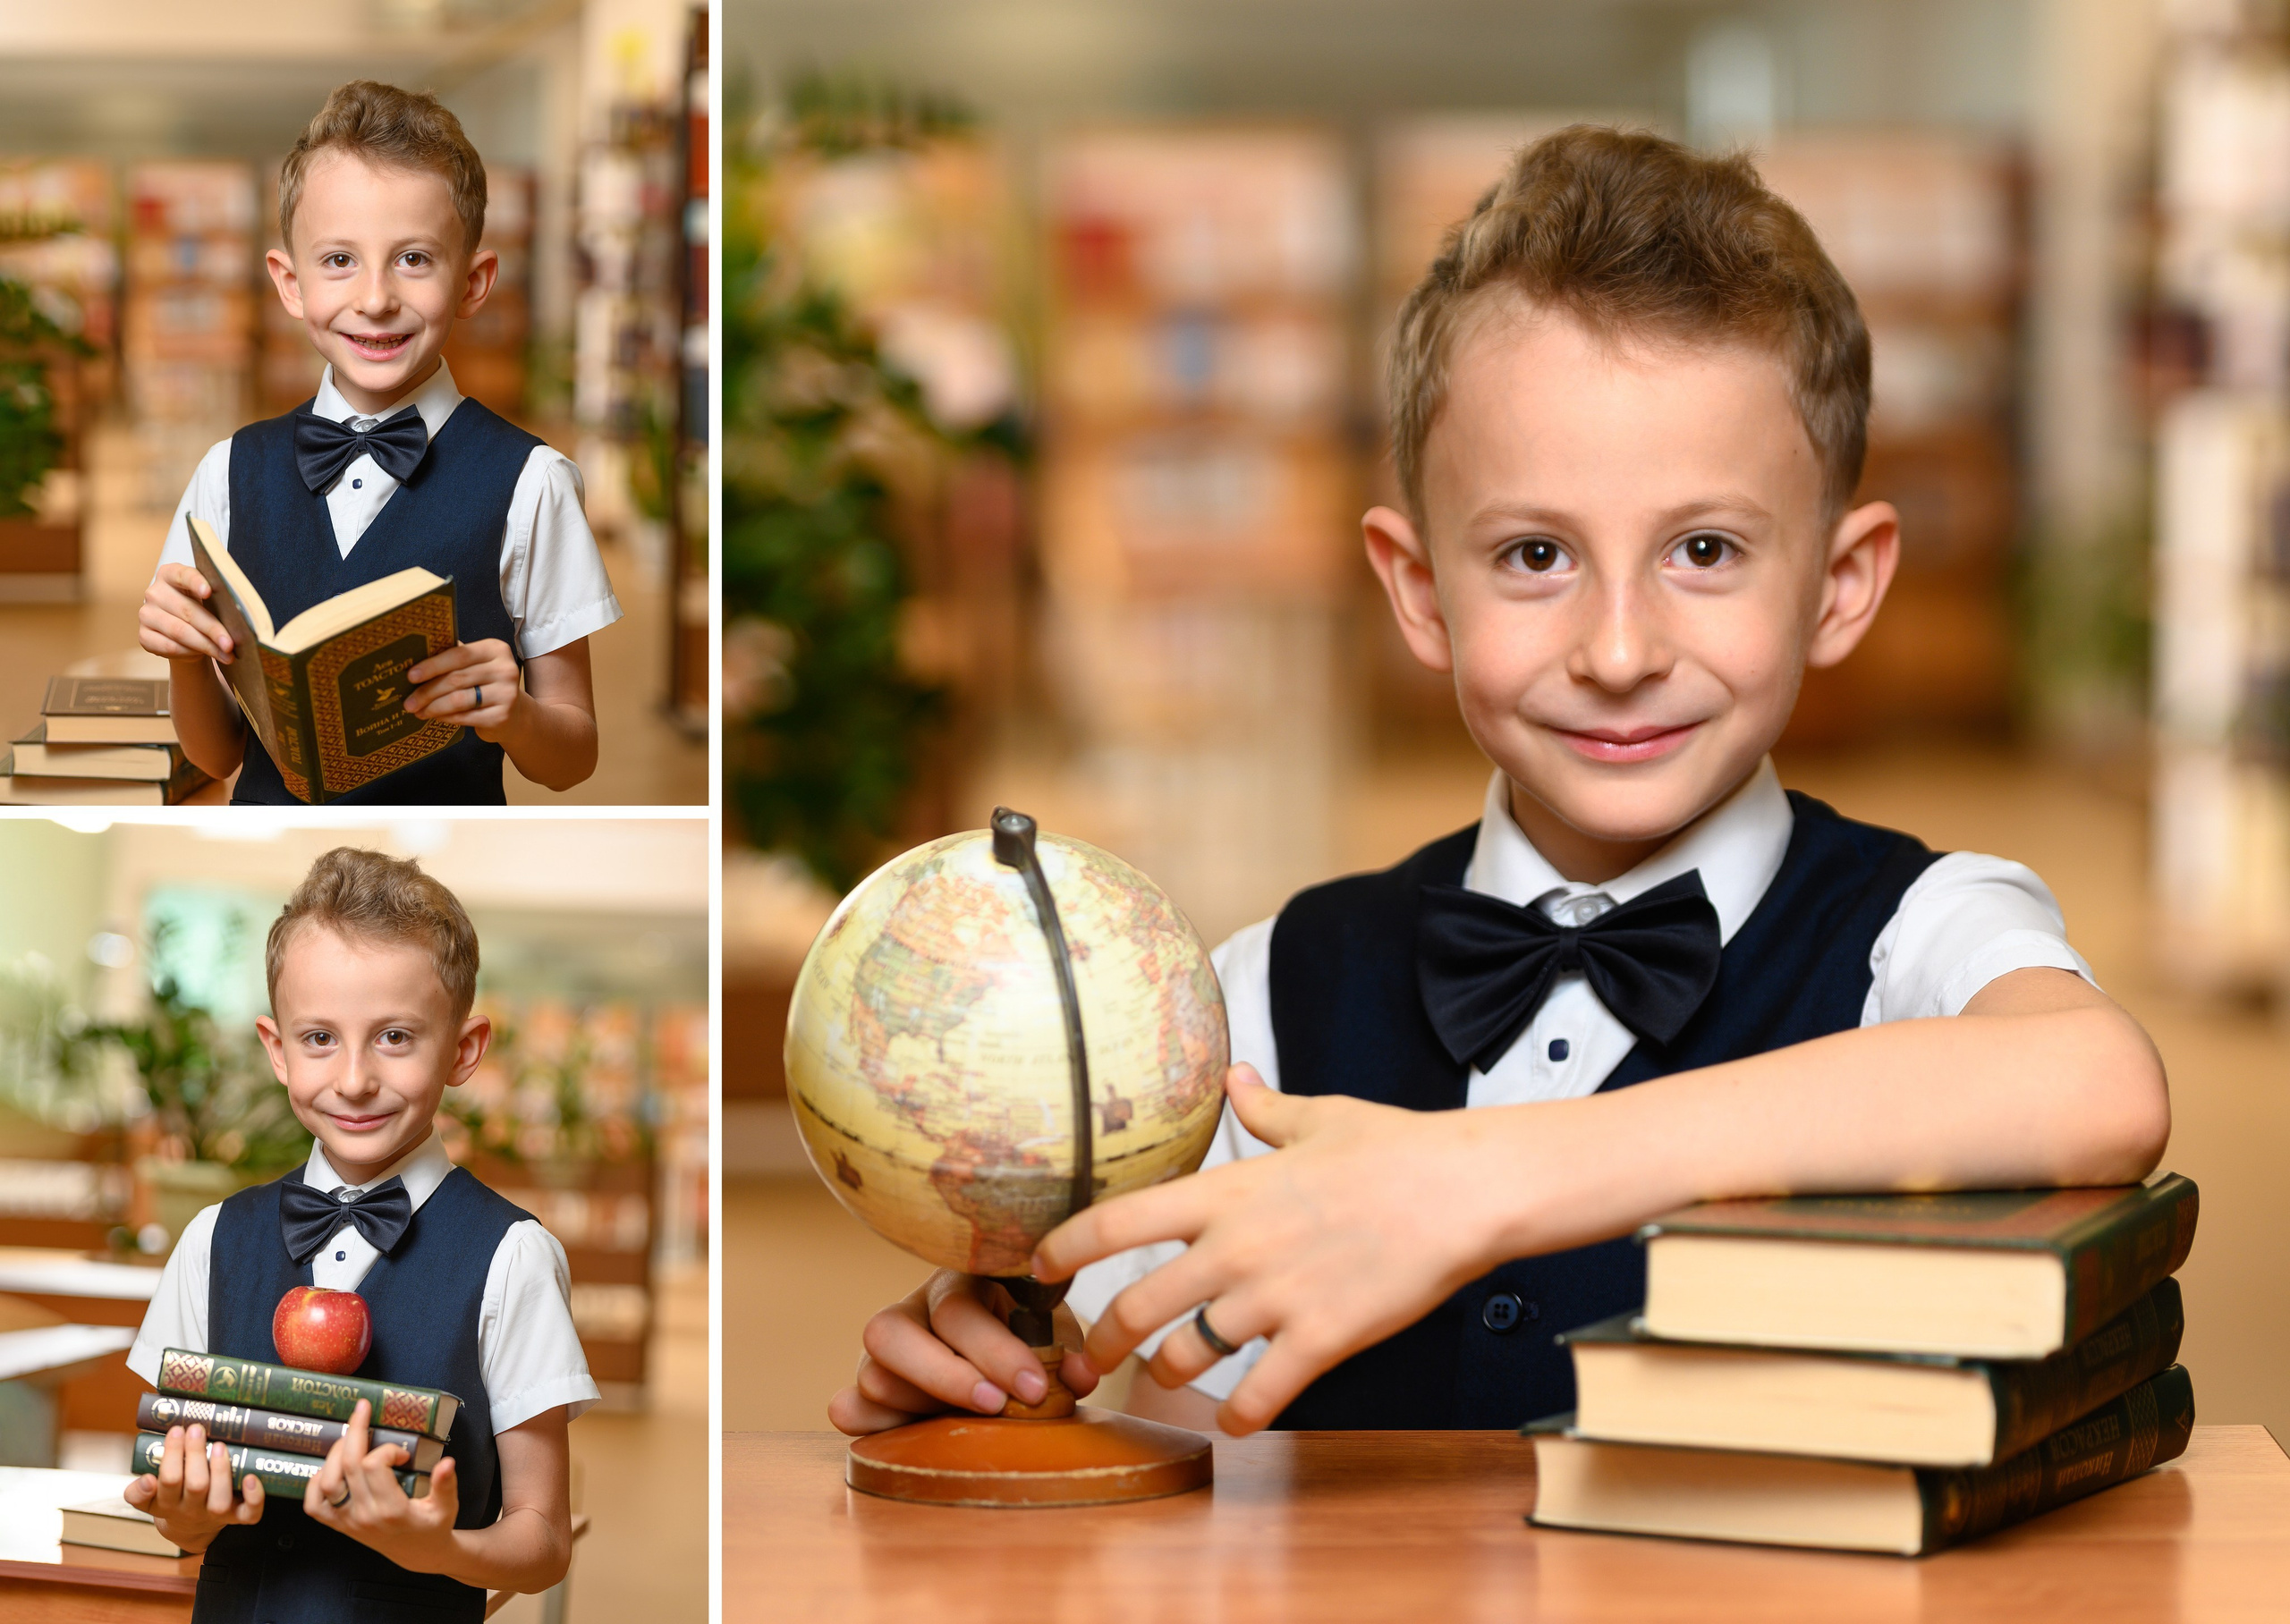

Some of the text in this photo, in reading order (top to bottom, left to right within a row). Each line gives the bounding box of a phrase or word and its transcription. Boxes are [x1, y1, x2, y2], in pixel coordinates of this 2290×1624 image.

[291, 1376, 360, 1401] ТОЛСТОЙ
[310, 1399, 335, 1415] Лев
[267, 1416, 324, 1437] ЛЕСКОВ
[2048, 1413, 2121, 1462] НЕКРАСОВ
[255, 1457, 322, 1478] ЕКРАСОВ
